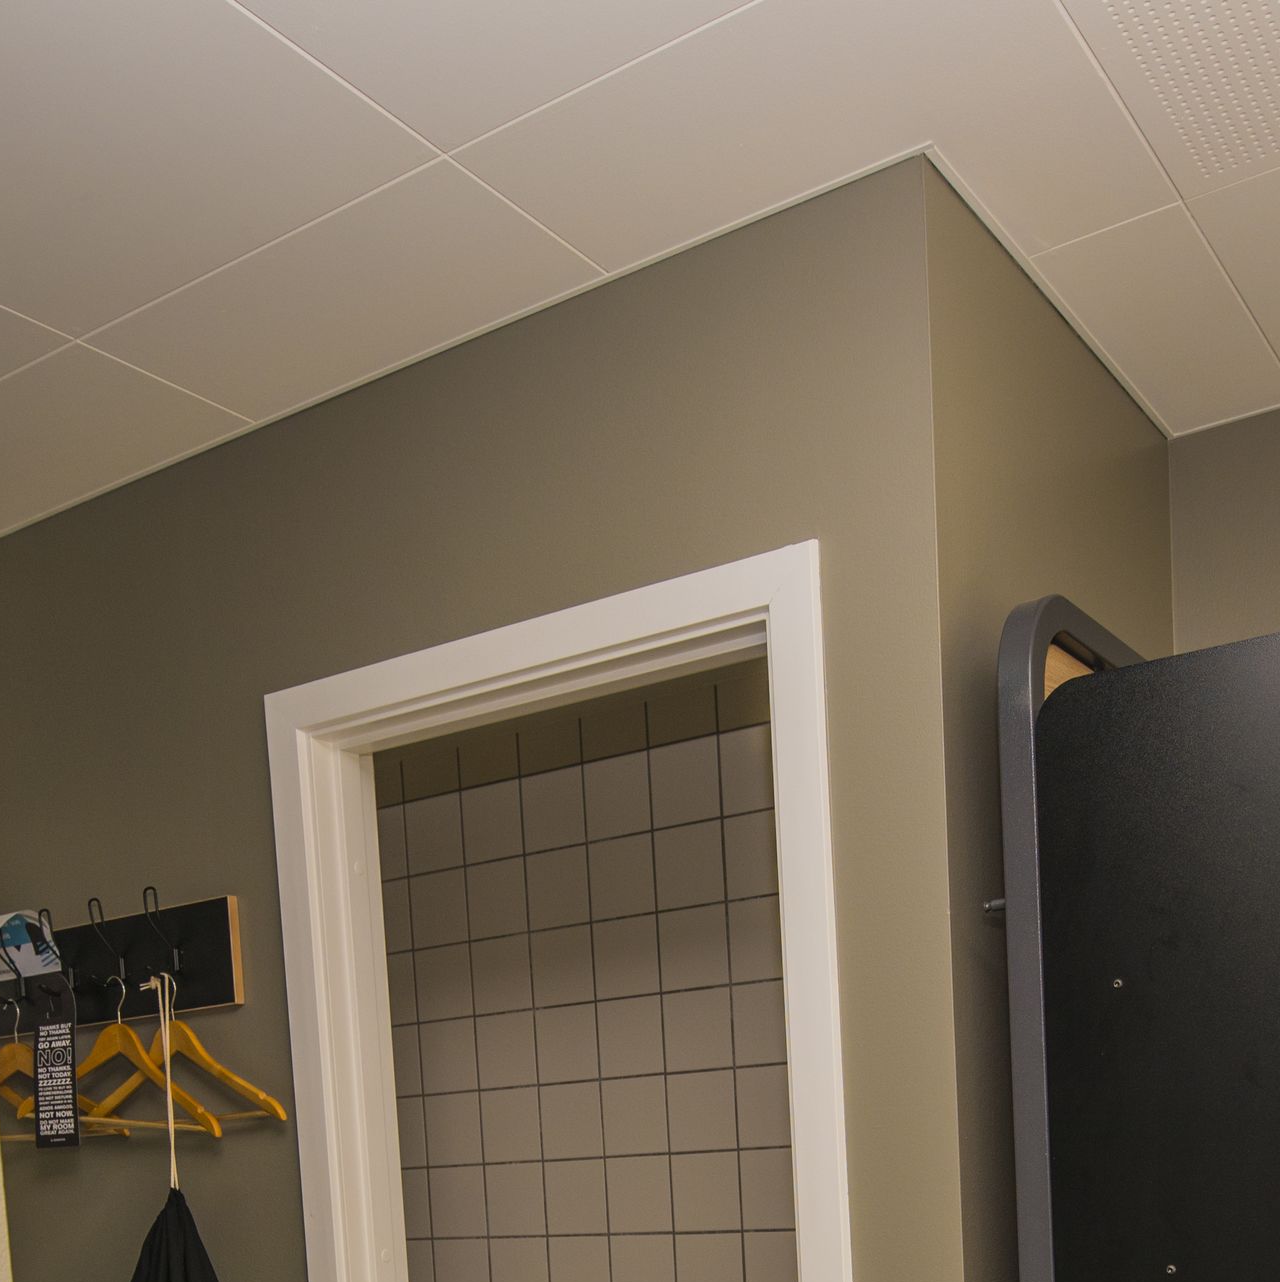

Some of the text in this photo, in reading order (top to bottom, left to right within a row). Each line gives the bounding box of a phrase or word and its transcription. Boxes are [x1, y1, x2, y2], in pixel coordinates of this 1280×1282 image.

[38, 1039, 72, 1050] GO AWAY.
[37, 1047, 72, 1067] NO!
[39, 1110, 74, 1119] NOT NOW.
[52, 1122, 74, 1130] ROOM
